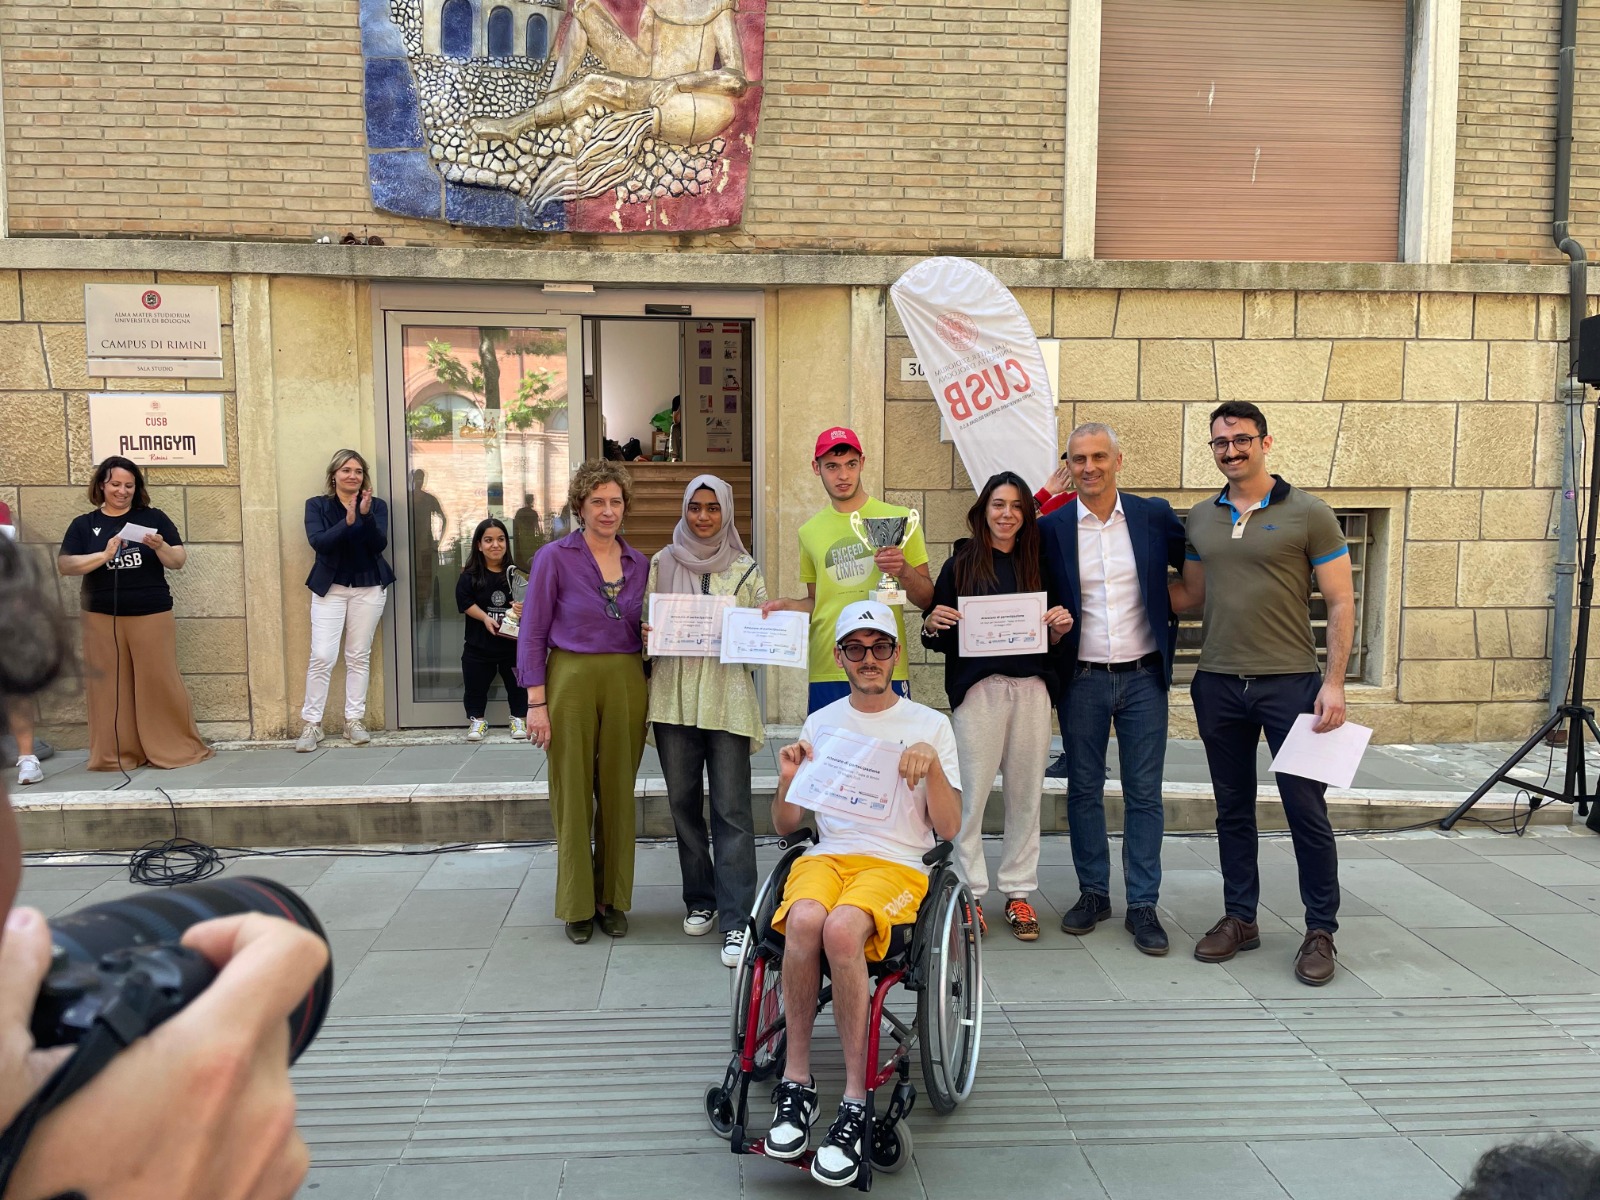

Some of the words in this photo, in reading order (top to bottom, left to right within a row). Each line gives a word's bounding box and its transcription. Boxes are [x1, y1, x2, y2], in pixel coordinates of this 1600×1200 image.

[101, 339, 147, 349] CAMPUS
[150, 340, 163, 349] DI
[167, 340, 207, 350] RIMINI
[145, 417, 168, 426] CUSB
[119, 435, 197, 456] ALMAGYM
[149, 453, 168, 461] Rimini
